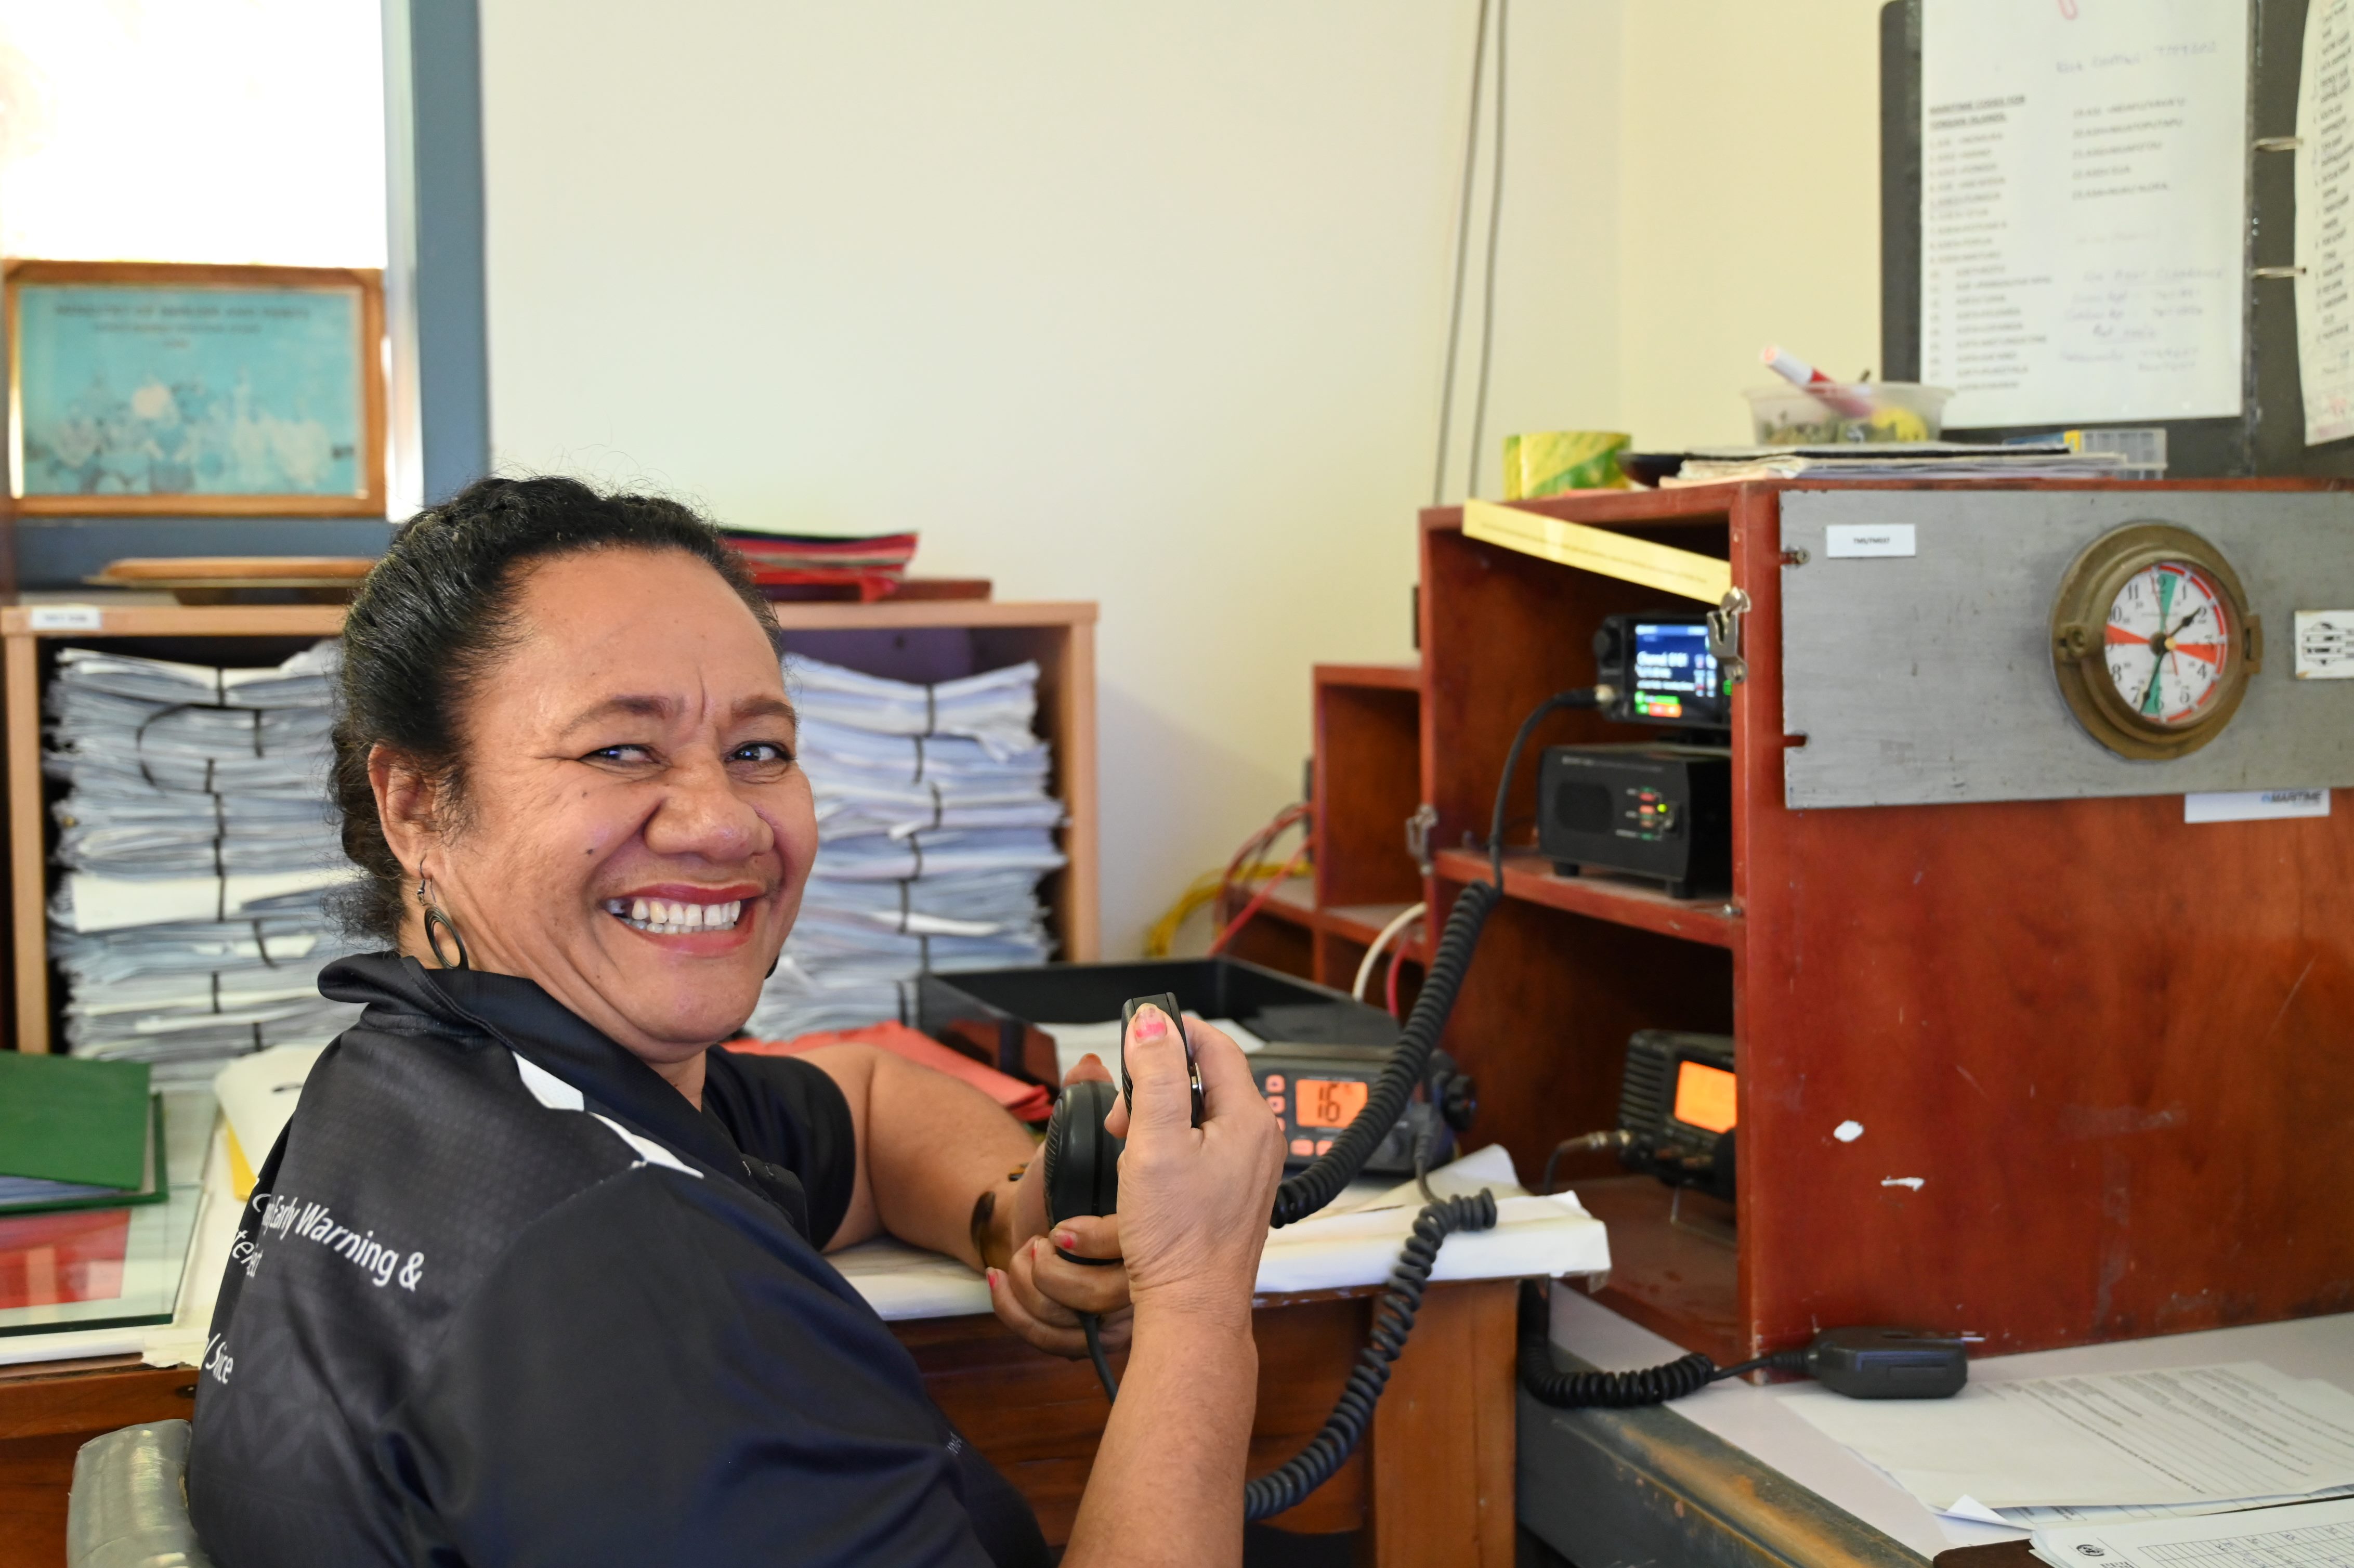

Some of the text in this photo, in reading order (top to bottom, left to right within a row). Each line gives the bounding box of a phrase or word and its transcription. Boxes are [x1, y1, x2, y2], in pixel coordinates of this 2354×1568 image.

[2128, 583, 2138, 600] 11
[2197, 606, 2207, 623] 2
[2111, 663, 2122, 685] 8
[2195, 662, 2208, 680] 4
[2130, 686, 2141, 704] 7
[294, 1201, 399, 1288] Warning
[398, 1251, 425, 1292] &
